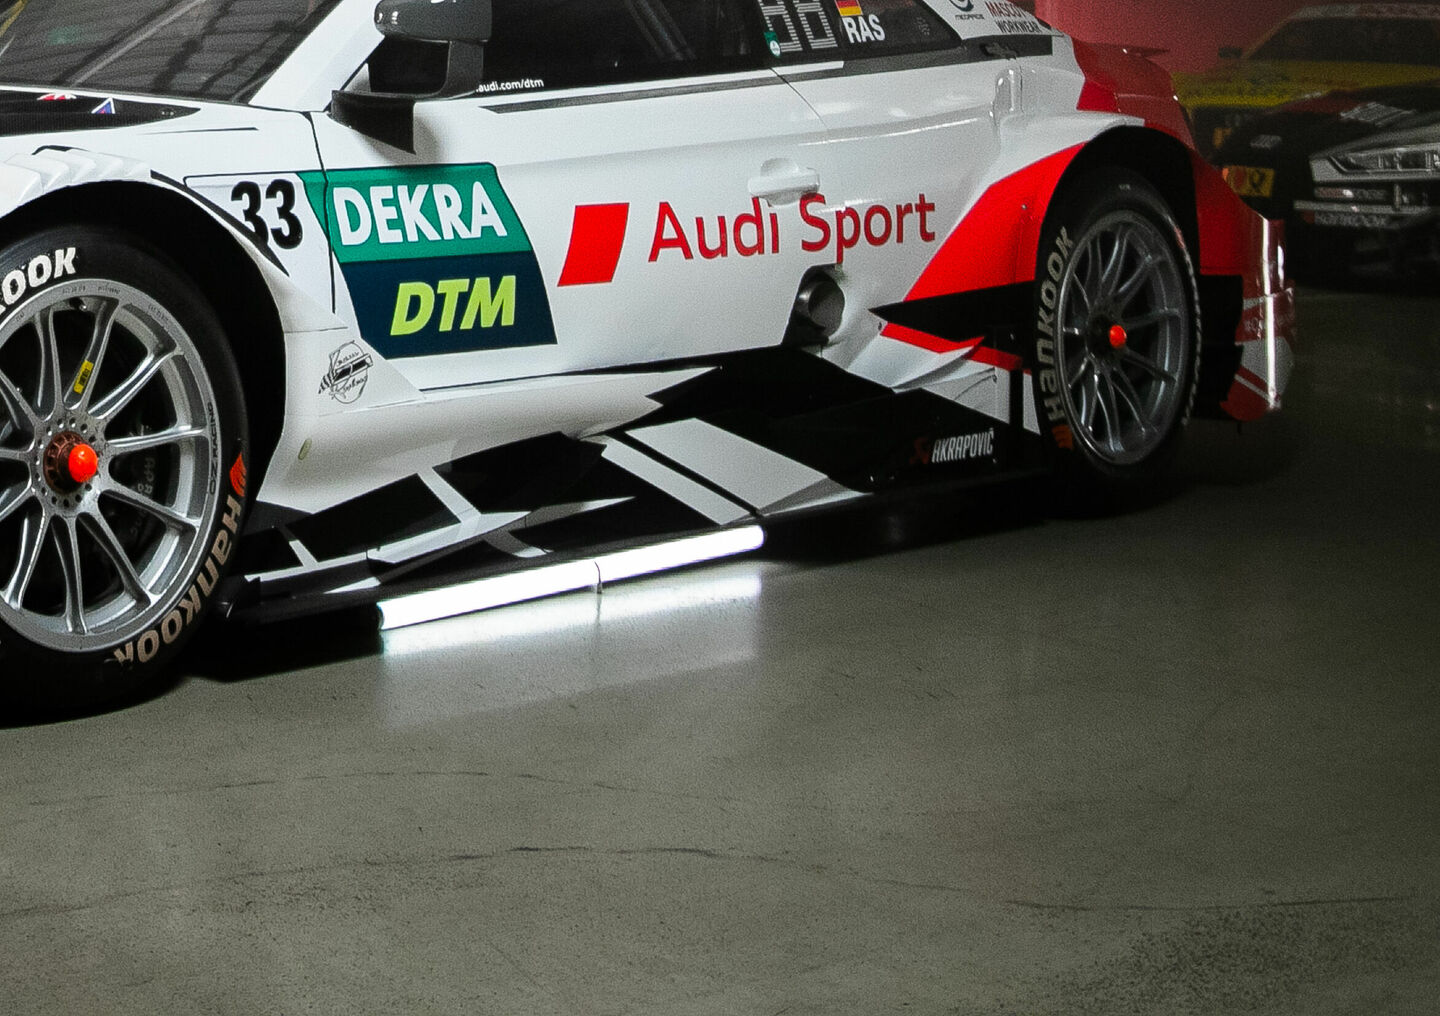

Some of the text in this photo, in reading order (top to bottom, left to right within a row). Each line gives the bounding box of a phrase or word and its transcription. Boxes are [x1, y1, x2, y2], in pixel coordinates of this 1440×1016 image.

[841, 14, 886, 44] RAS
[231, 178, 303, 250] 33
[333, 181, 508, 246] DEKRA
[647, 191, 936, 265] Audi Sport
[390, 275, 516, 336] DTM
